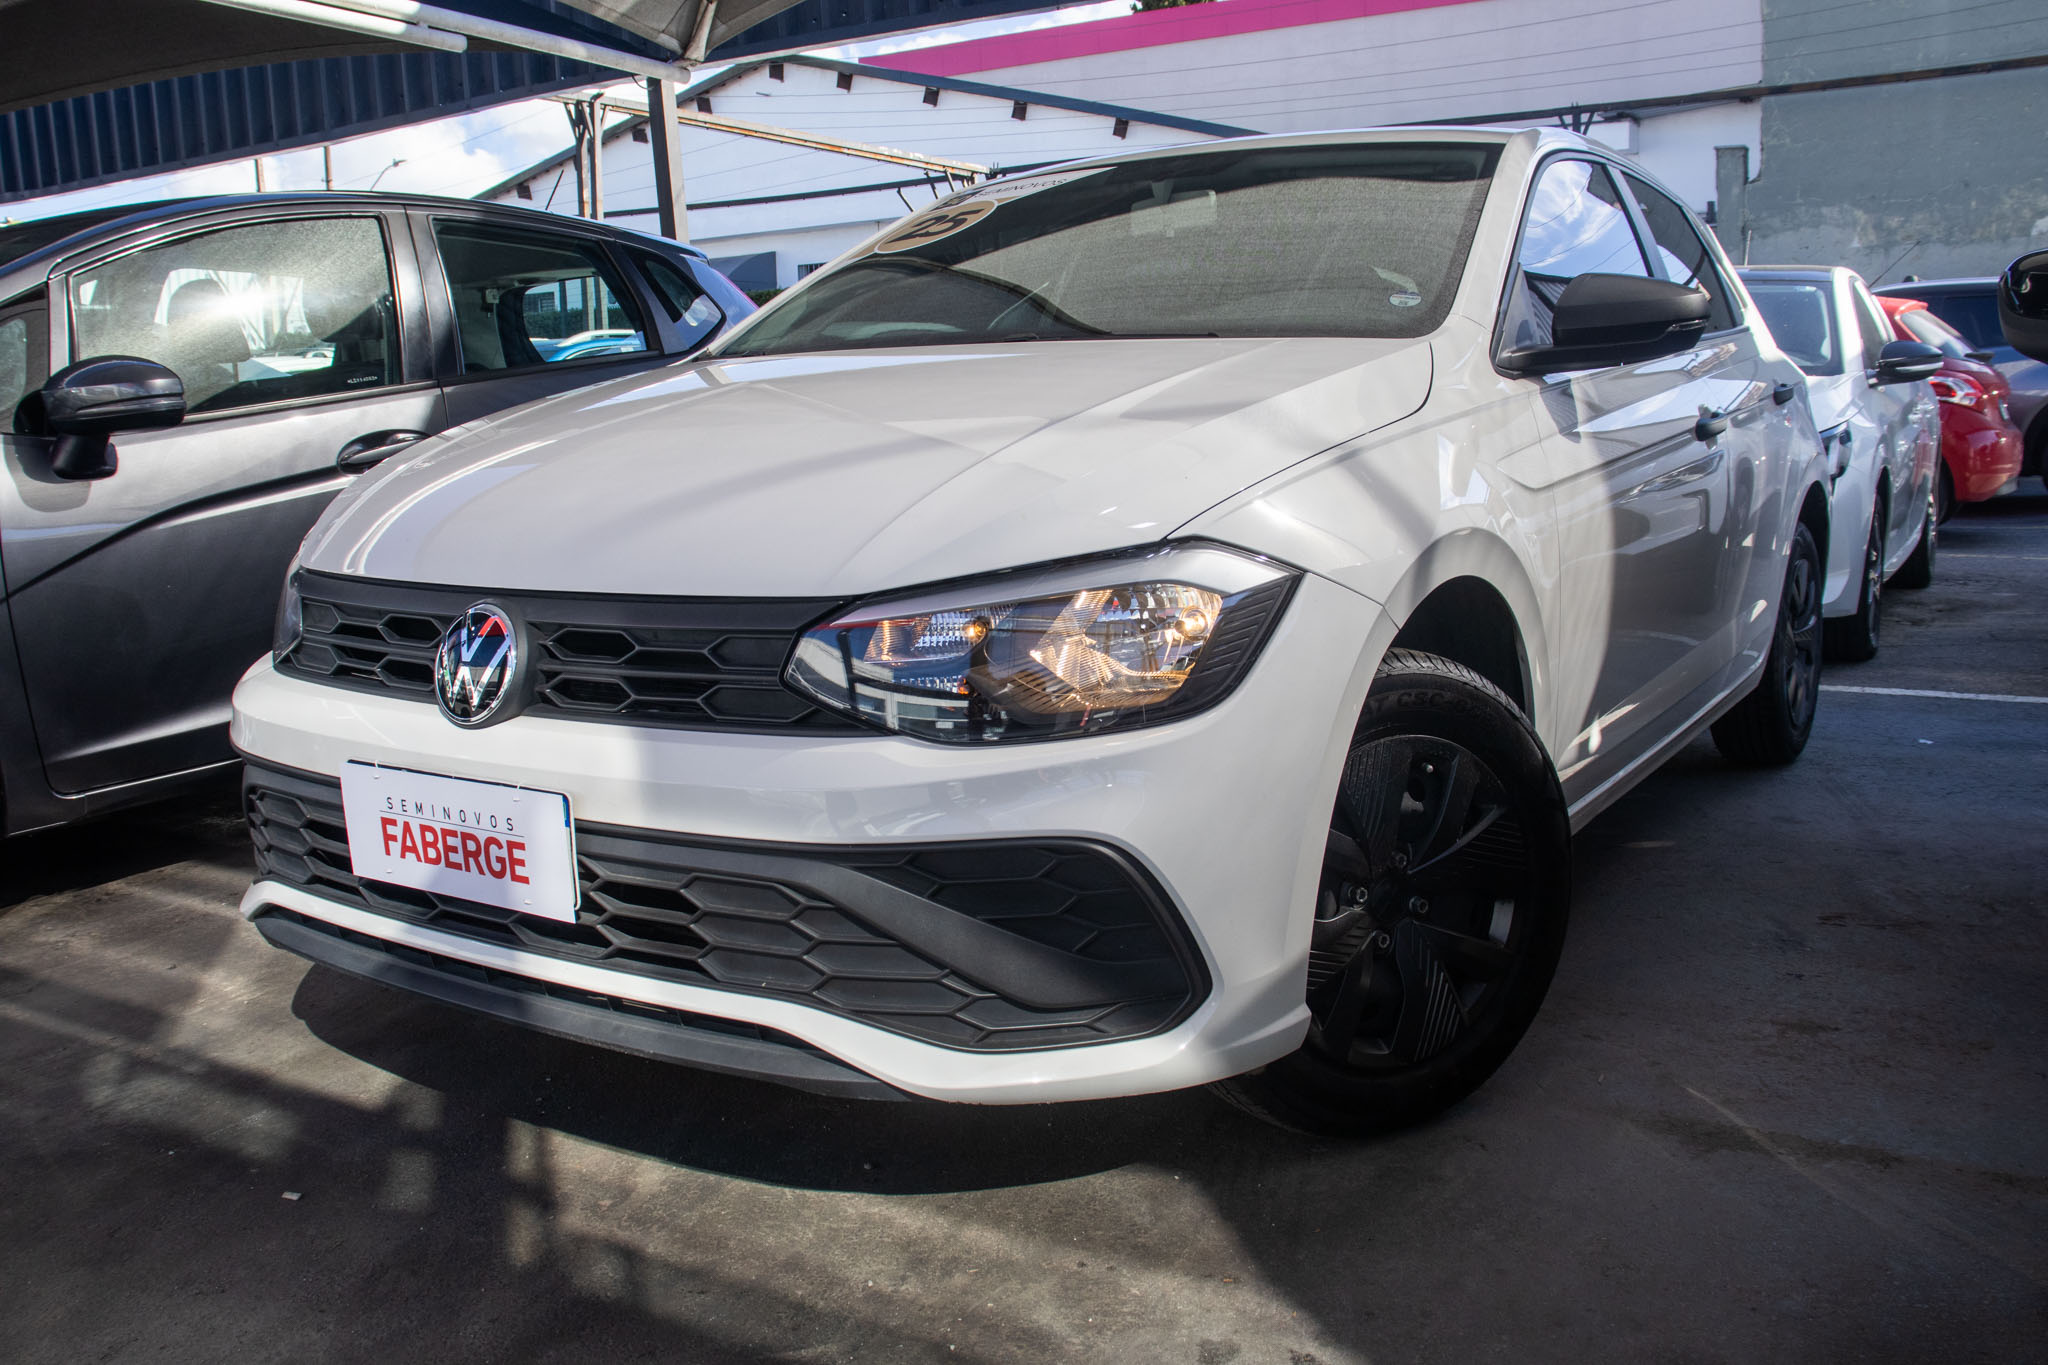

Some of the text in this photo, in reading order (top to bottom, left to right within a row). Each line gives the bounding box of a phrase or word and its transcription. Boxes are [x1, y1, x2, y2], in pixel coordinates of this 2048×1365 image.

[884, 208, 985, 245] 25
[386, 796, 515, 832] SEMINOVOS
[380, 816, 530, 886] FABERGE
